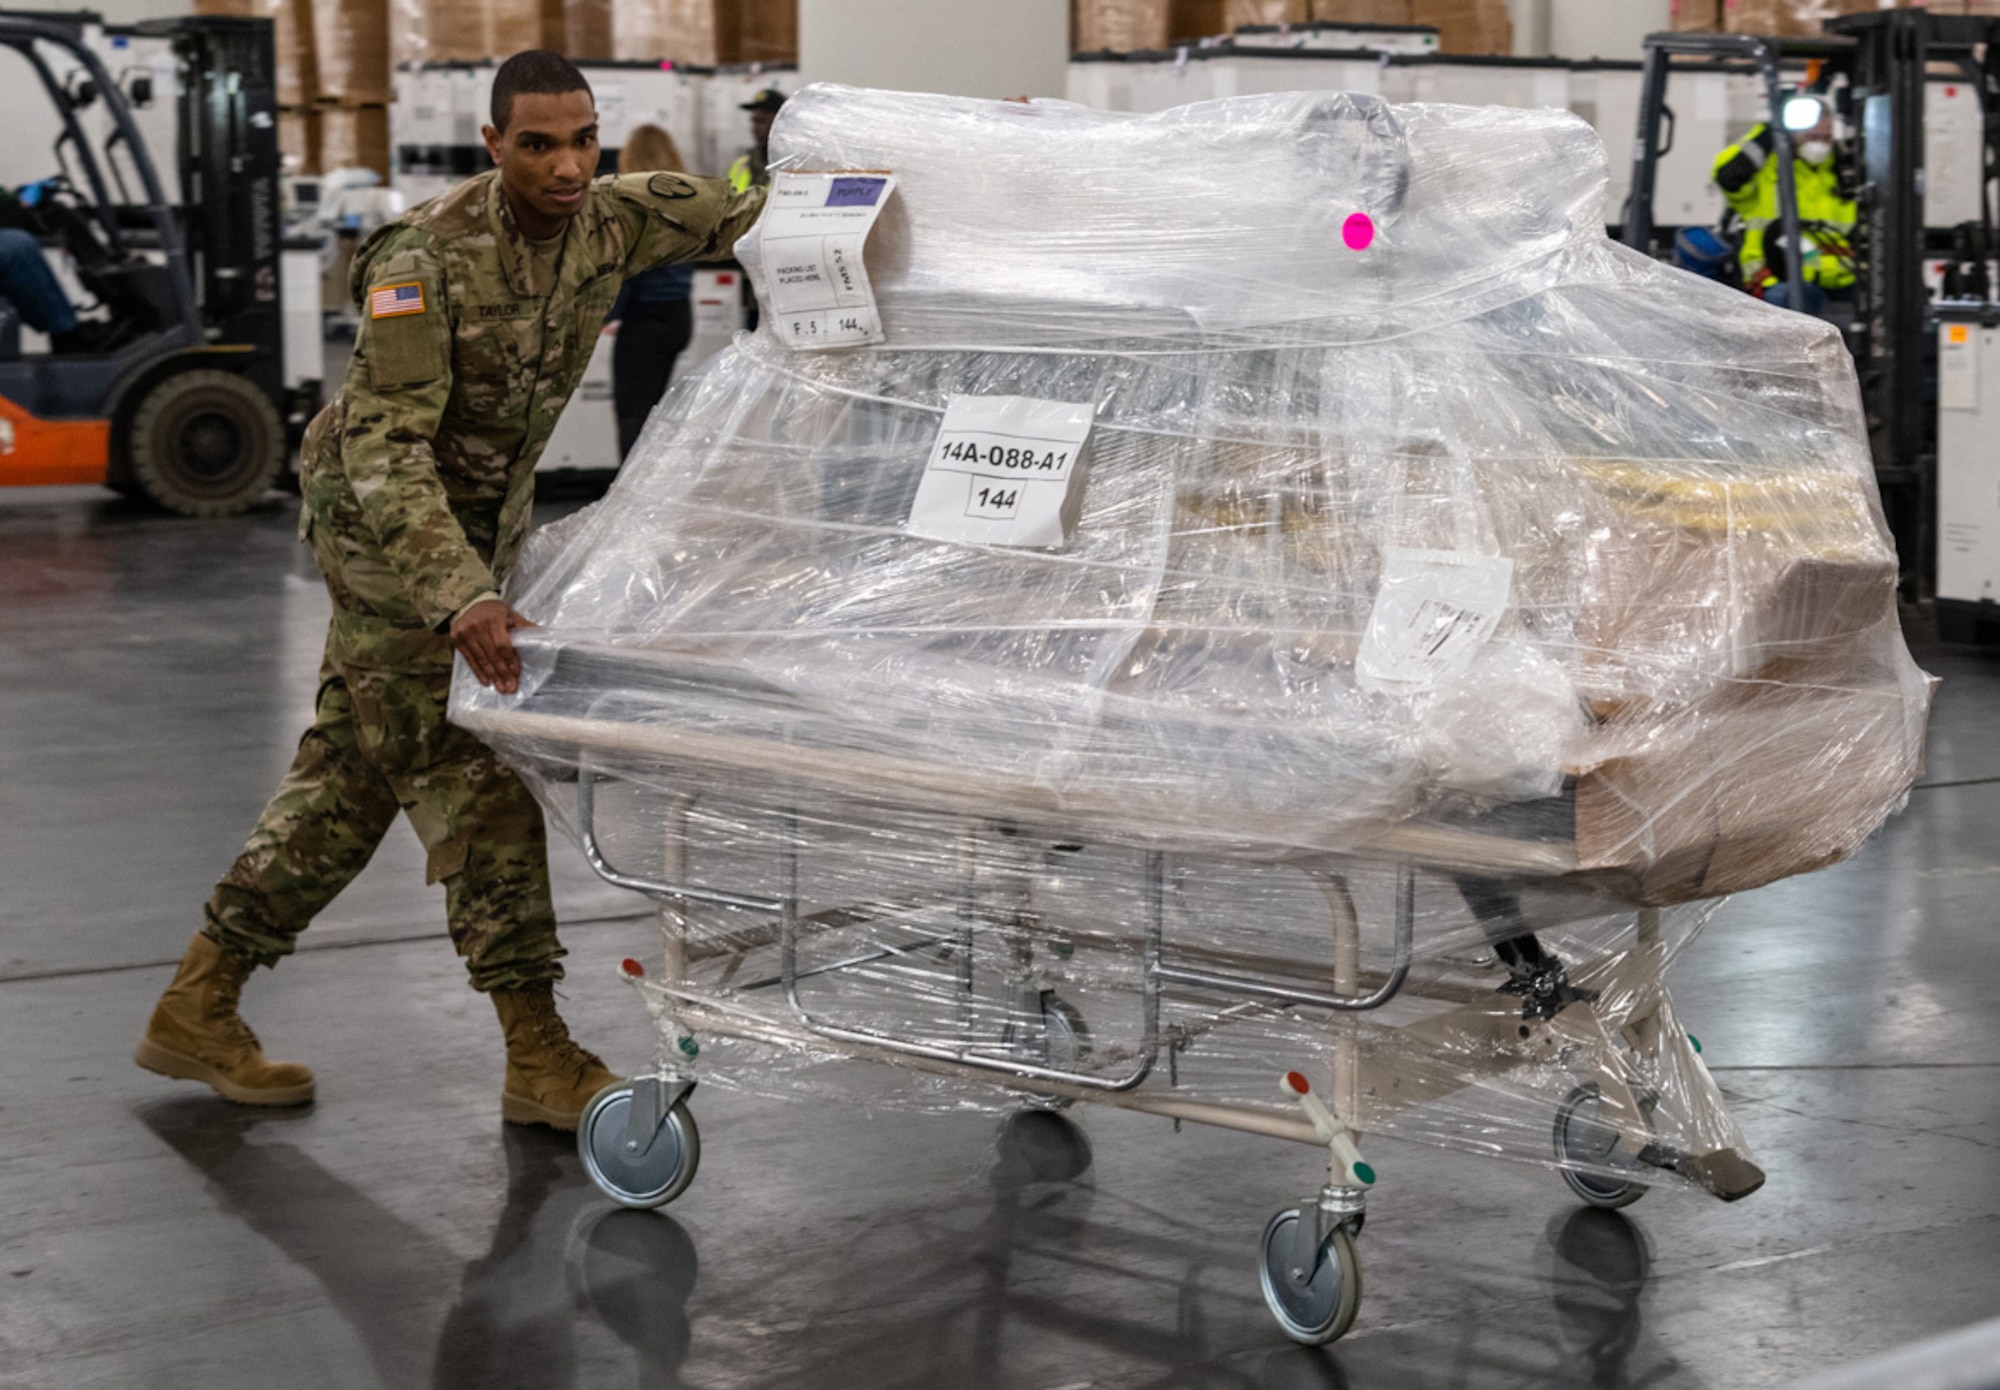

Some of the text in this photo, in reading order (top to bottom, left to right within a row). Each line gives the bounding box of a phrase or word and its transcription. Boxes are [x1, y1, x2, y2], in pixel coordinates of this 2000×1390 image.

[777, 266, 803, 275] PACKING
[479, 303, 520, 317] TAYLOR
[942, 442, 1067, 470] 14A-088-A1
[978, 488, 1017, 509] 144
